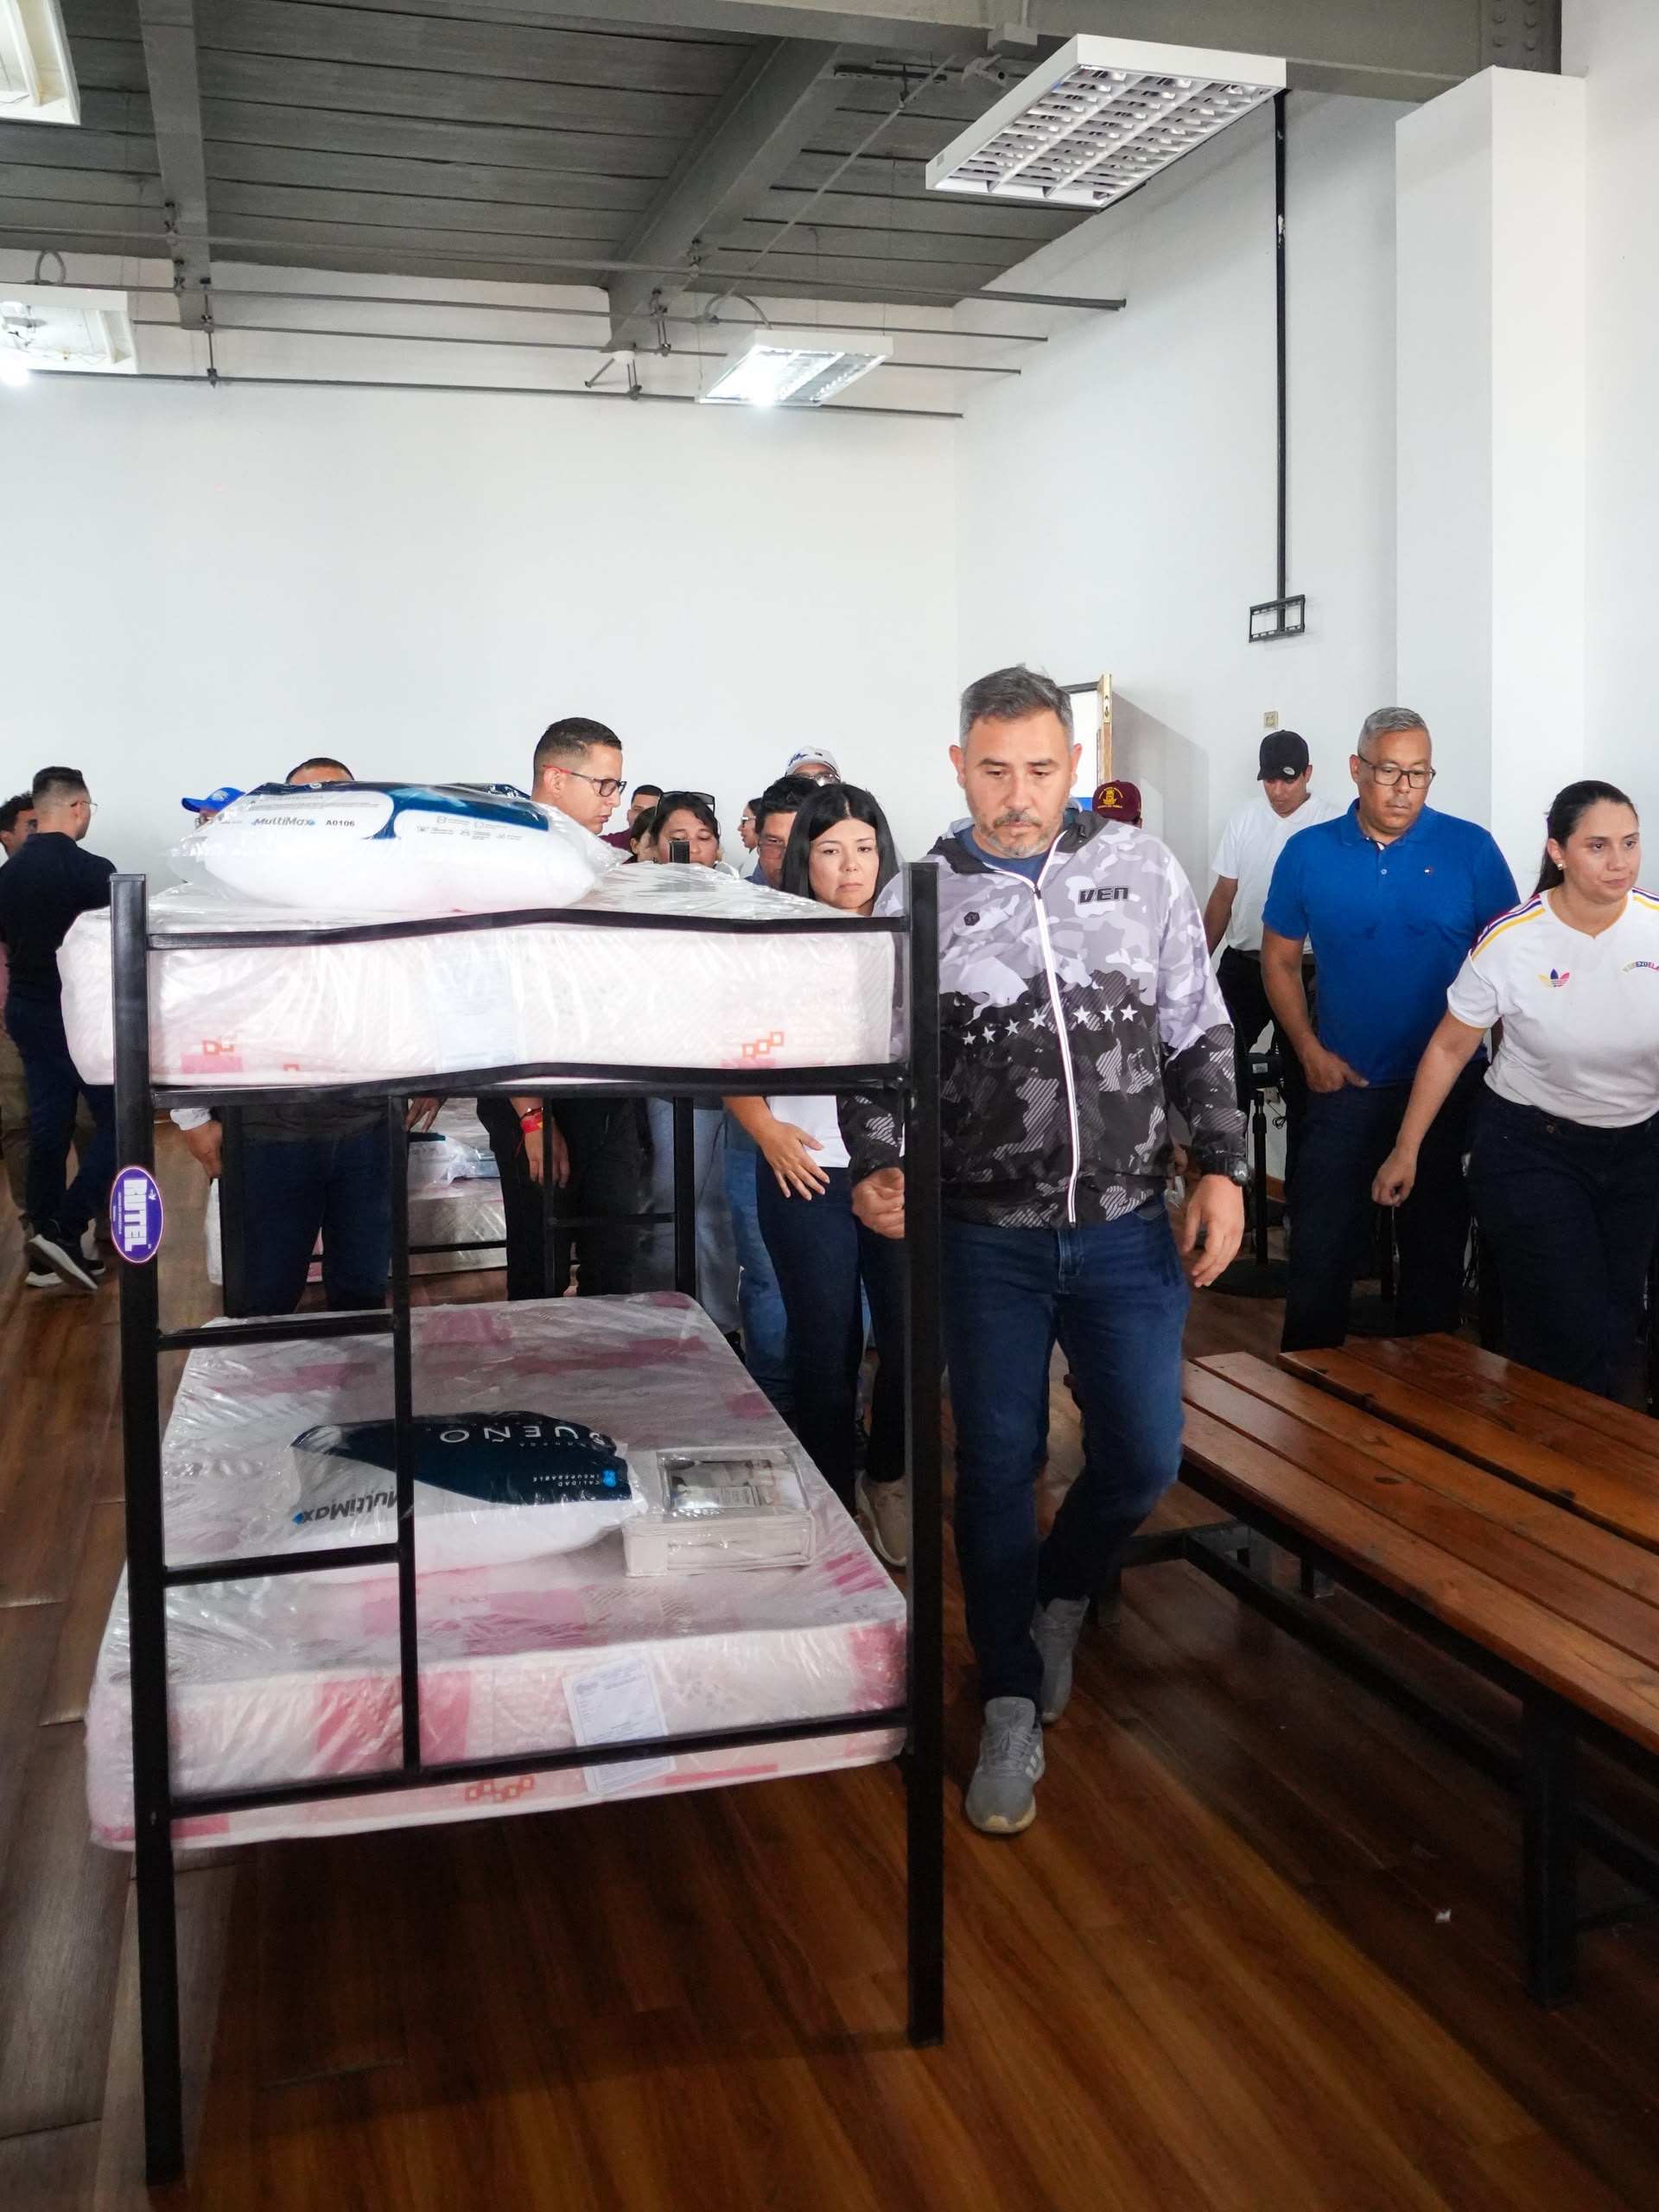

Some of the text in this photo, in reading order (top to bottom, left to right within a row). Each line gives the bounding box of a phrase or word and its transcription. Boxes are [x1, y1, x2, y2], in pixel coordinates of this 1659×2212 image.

[254, 817, 311, 827] MultiMax
[124, 1179, 148, 1252] RUTEL
[440, 1426, 606, 1446] SUEÑO
[533, 1474, 600, 1483] INSUPERABLE
